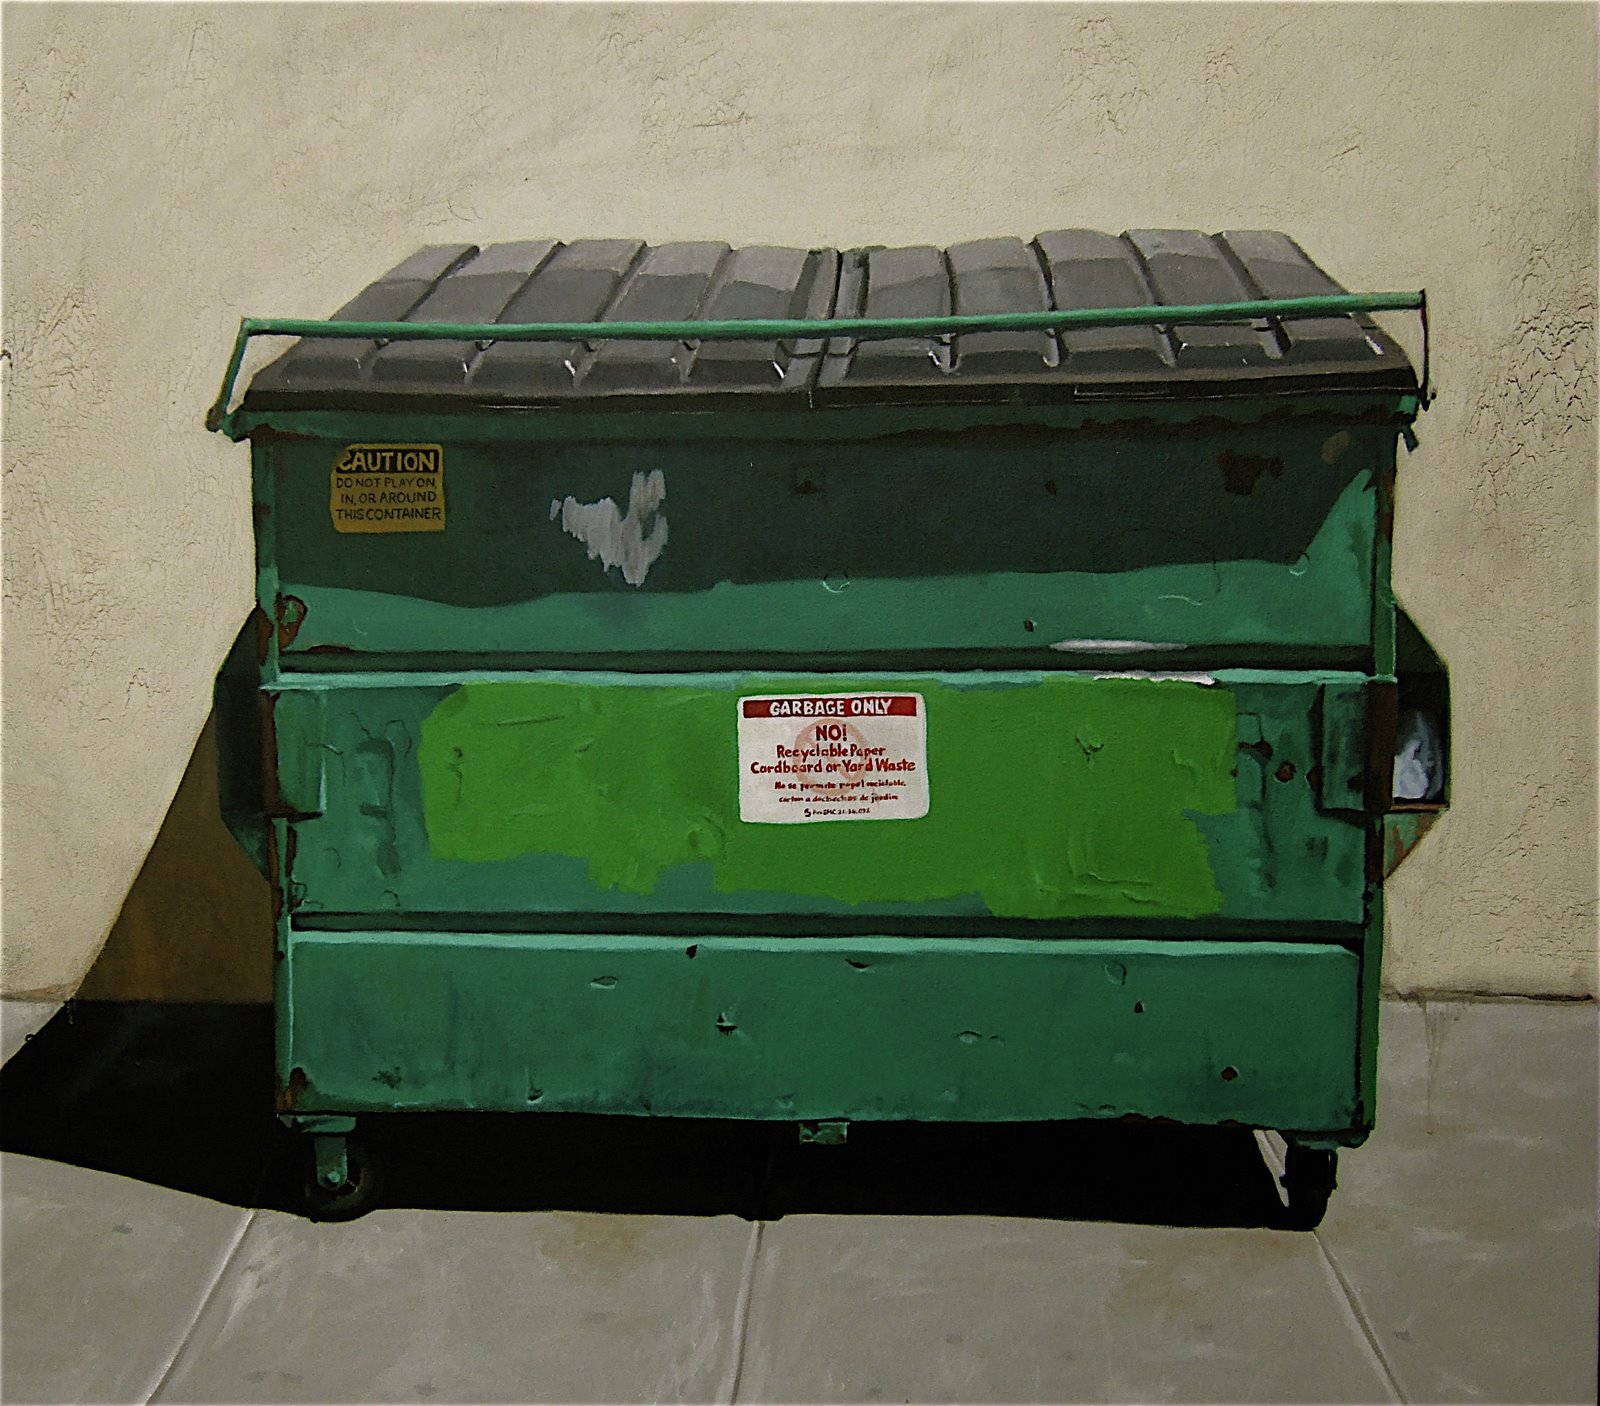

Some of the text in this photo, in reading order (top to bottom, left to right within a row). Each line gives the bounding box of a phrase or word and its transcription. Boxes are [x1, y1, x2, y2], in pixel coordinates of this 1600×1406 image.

[336, 477, 353, 488] DO
[355, 477, 381, 488] NOT
[384, 477, 413, 488] PLAY
[359, 493, 376, 504] OR
[380, 491, 437, 504] AROUND
[336, 507, 441, 520] THIS CONTAINER
[769, 698, 892, 716] GARBAGE ONLY
[815, 724, 848, 741] NO!
[776, 743, 886, 762] Recyclable Paper
[751, 758, 916, 774] Cardboard or Yard Waste
